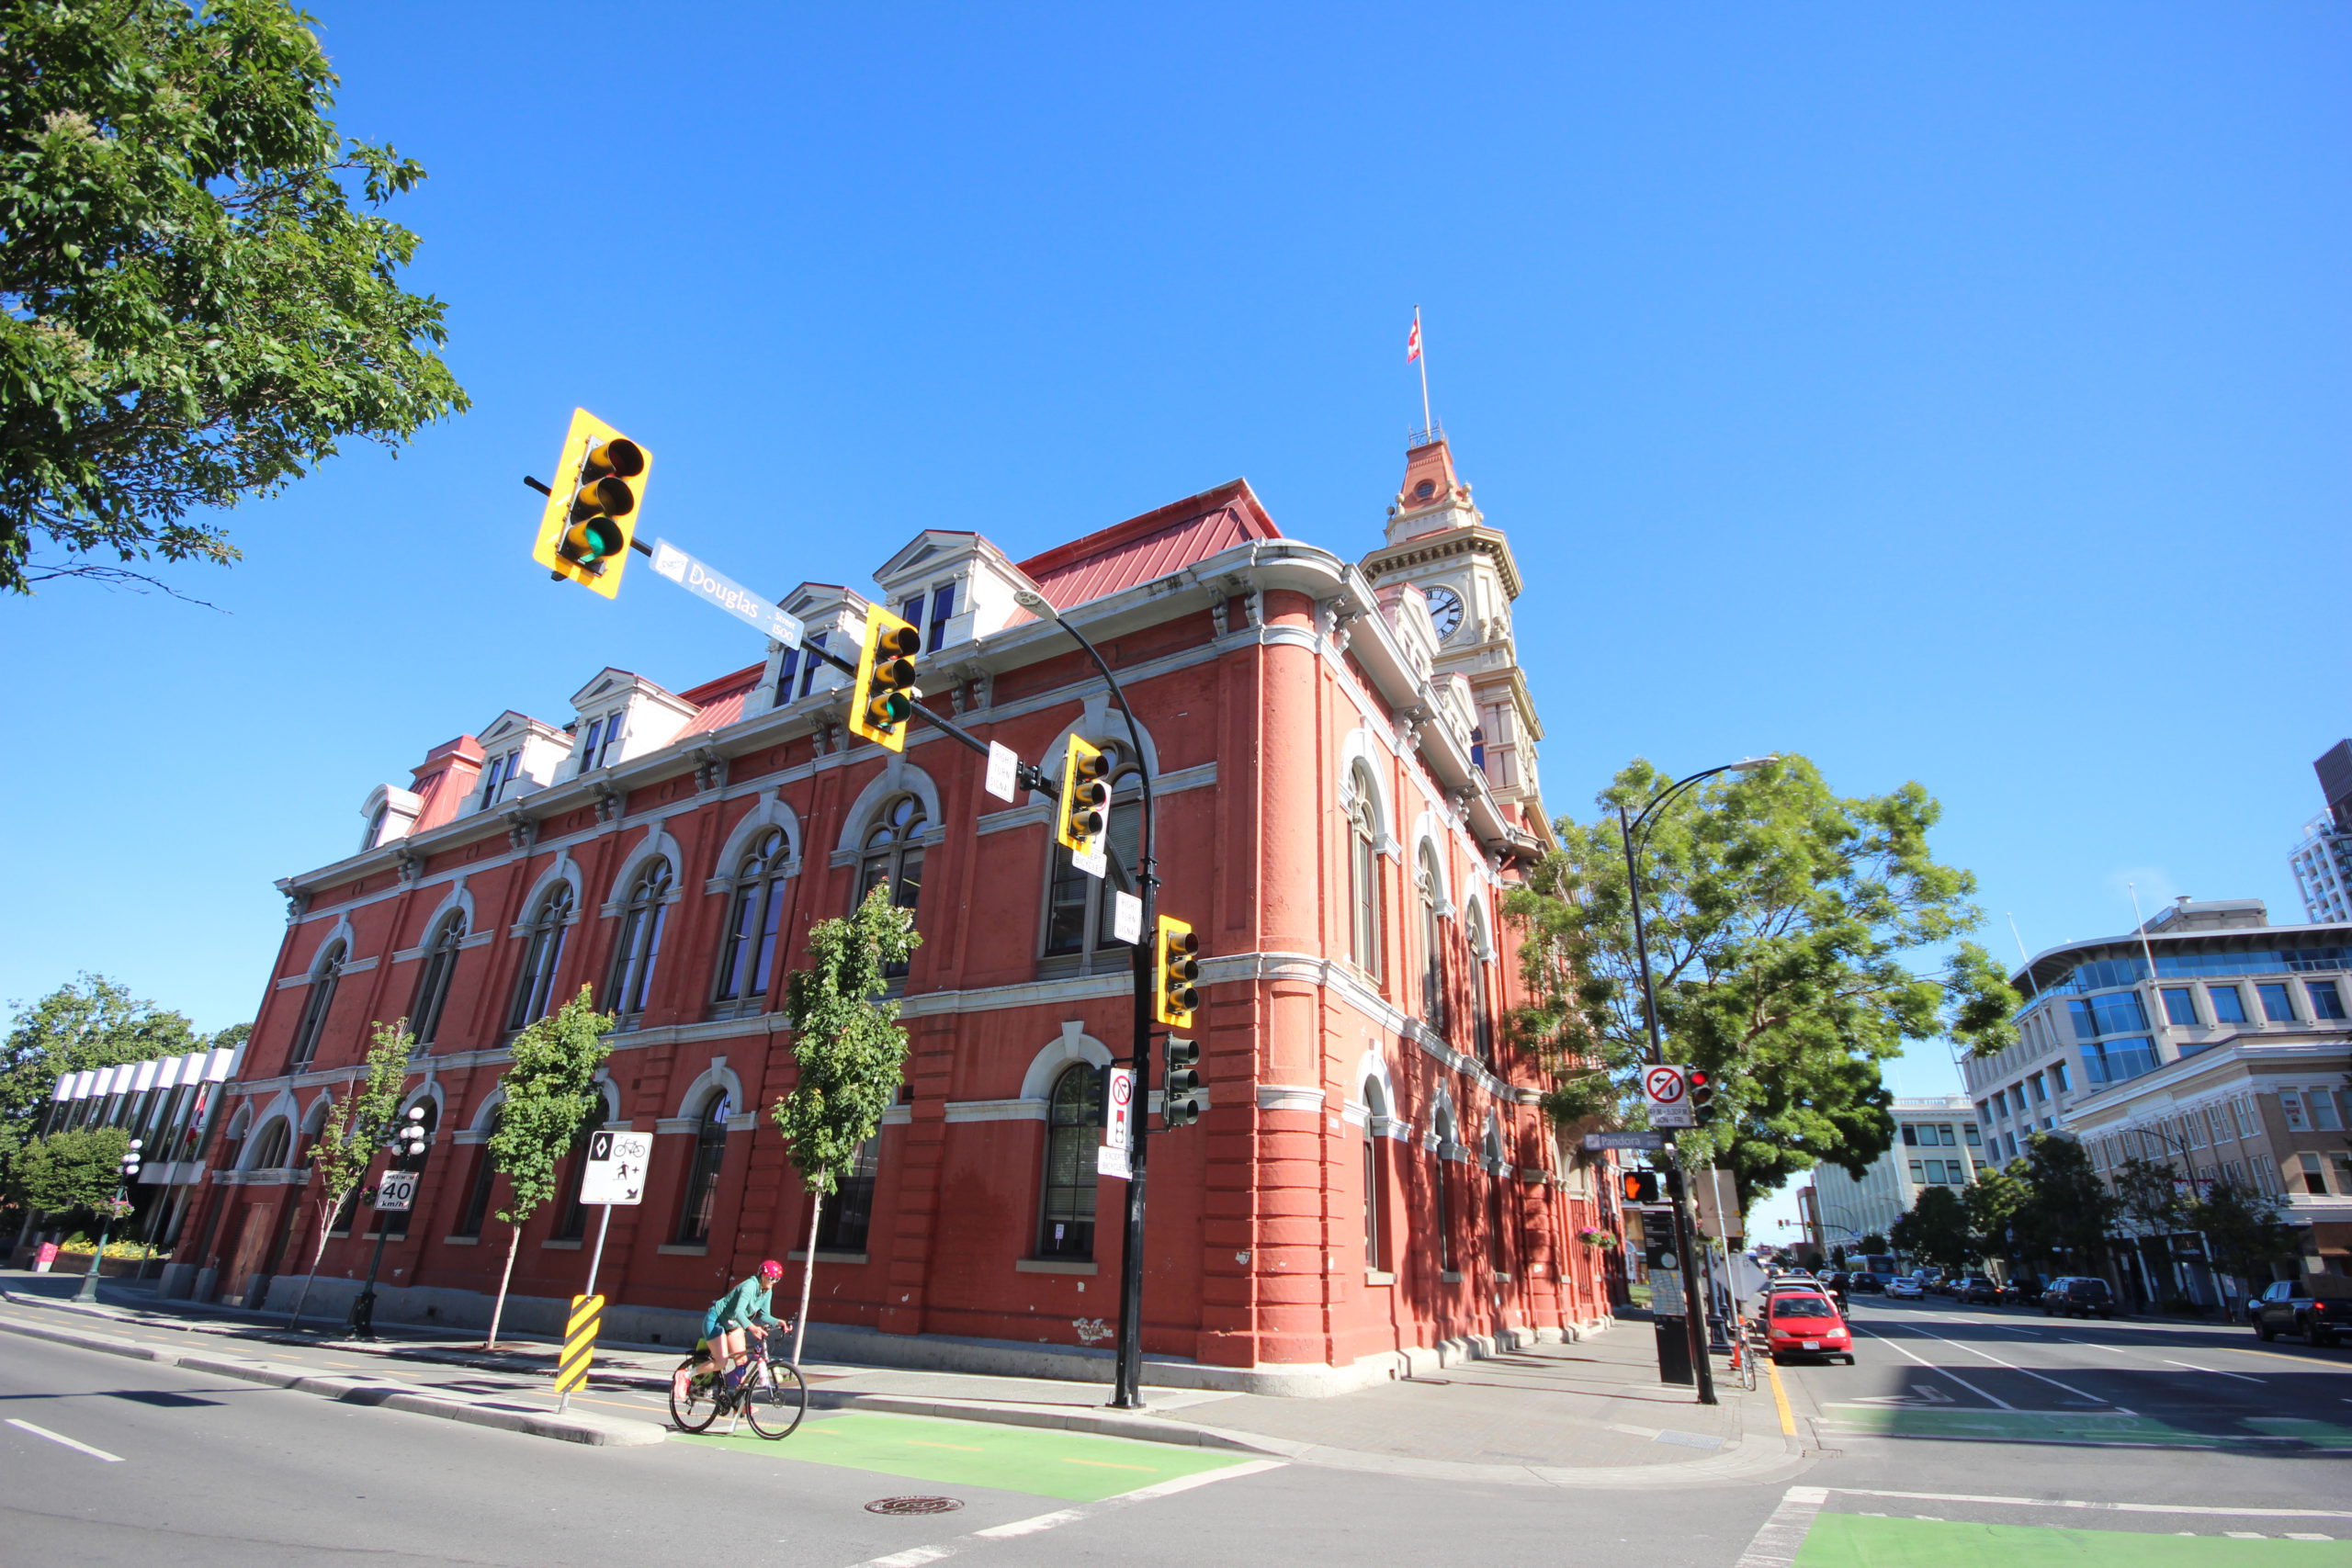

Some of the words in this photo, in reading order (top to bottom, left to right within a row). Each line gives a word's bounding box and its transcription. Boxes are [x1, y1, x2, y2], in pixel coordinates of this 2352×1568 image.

[688, 563, 760, 619] Douglas
[775, 612, 797, 630] Street
[772, 623, 795, 642] 1500
[995, 749, 1012, 765] RIGHT
[993, 763, 1011, 780] TURN
[989, 776, 1011, 795] SIGNAL
[1075, 855, 1103, 874] BICYCLES
[1121, 897, 1137, 910] RIGHT
[1601, 1135, 1641, 1146] Pandora
[382, 1181, 411, 1200] 40
